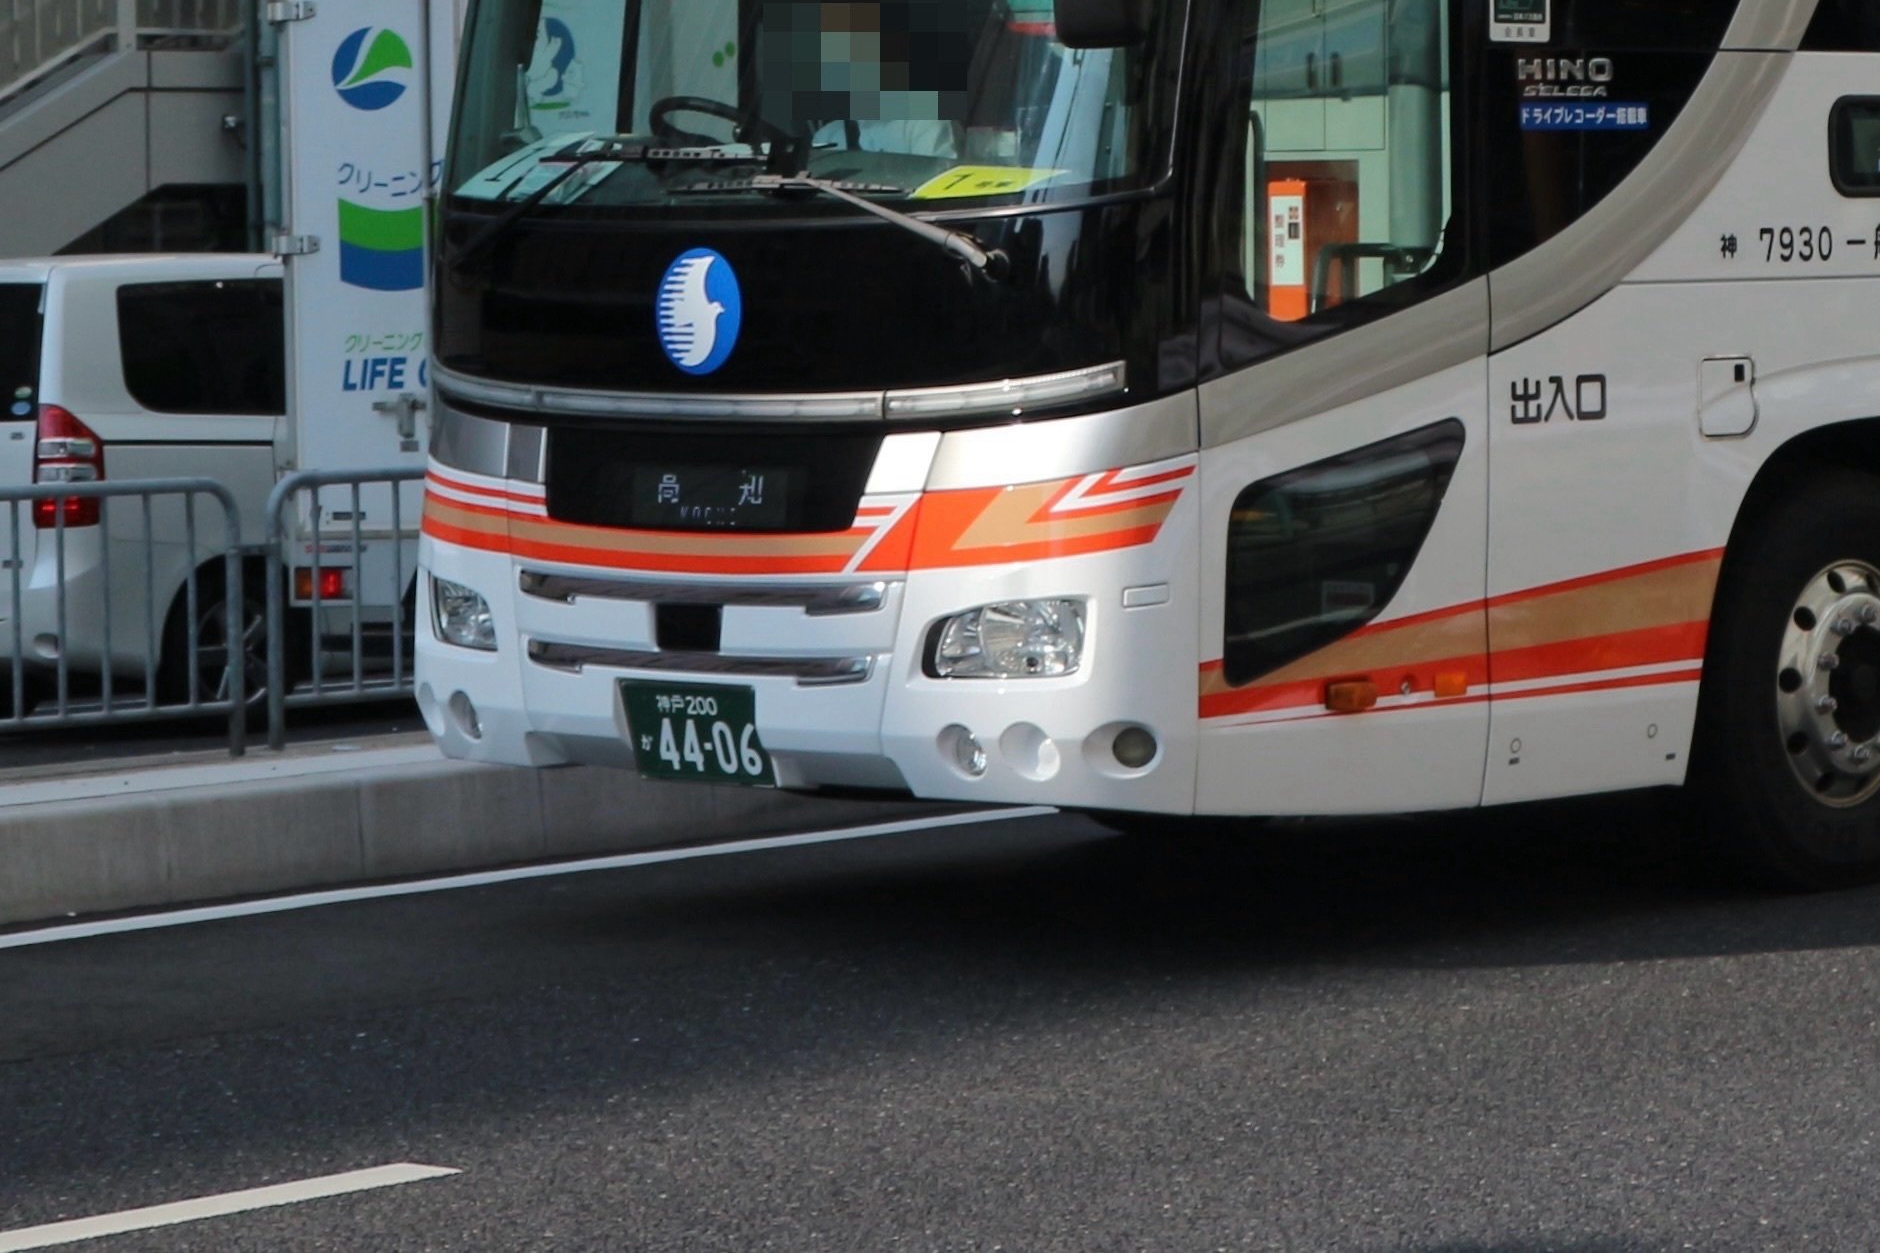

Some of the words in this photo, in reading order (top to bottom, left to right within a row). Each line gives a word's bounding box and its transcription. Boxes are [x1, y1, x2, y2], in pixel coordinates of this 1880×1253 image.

[1517, 57, 1612, 81] HINO
[1720, 234, 1738, 259] 神
[1759, 226, 1834, 263] 7930
[342, 357, 407, 391] LIFE
[1511, 373, 1607, 425] 出入口
[660, 717, 763, 776] 44-06
